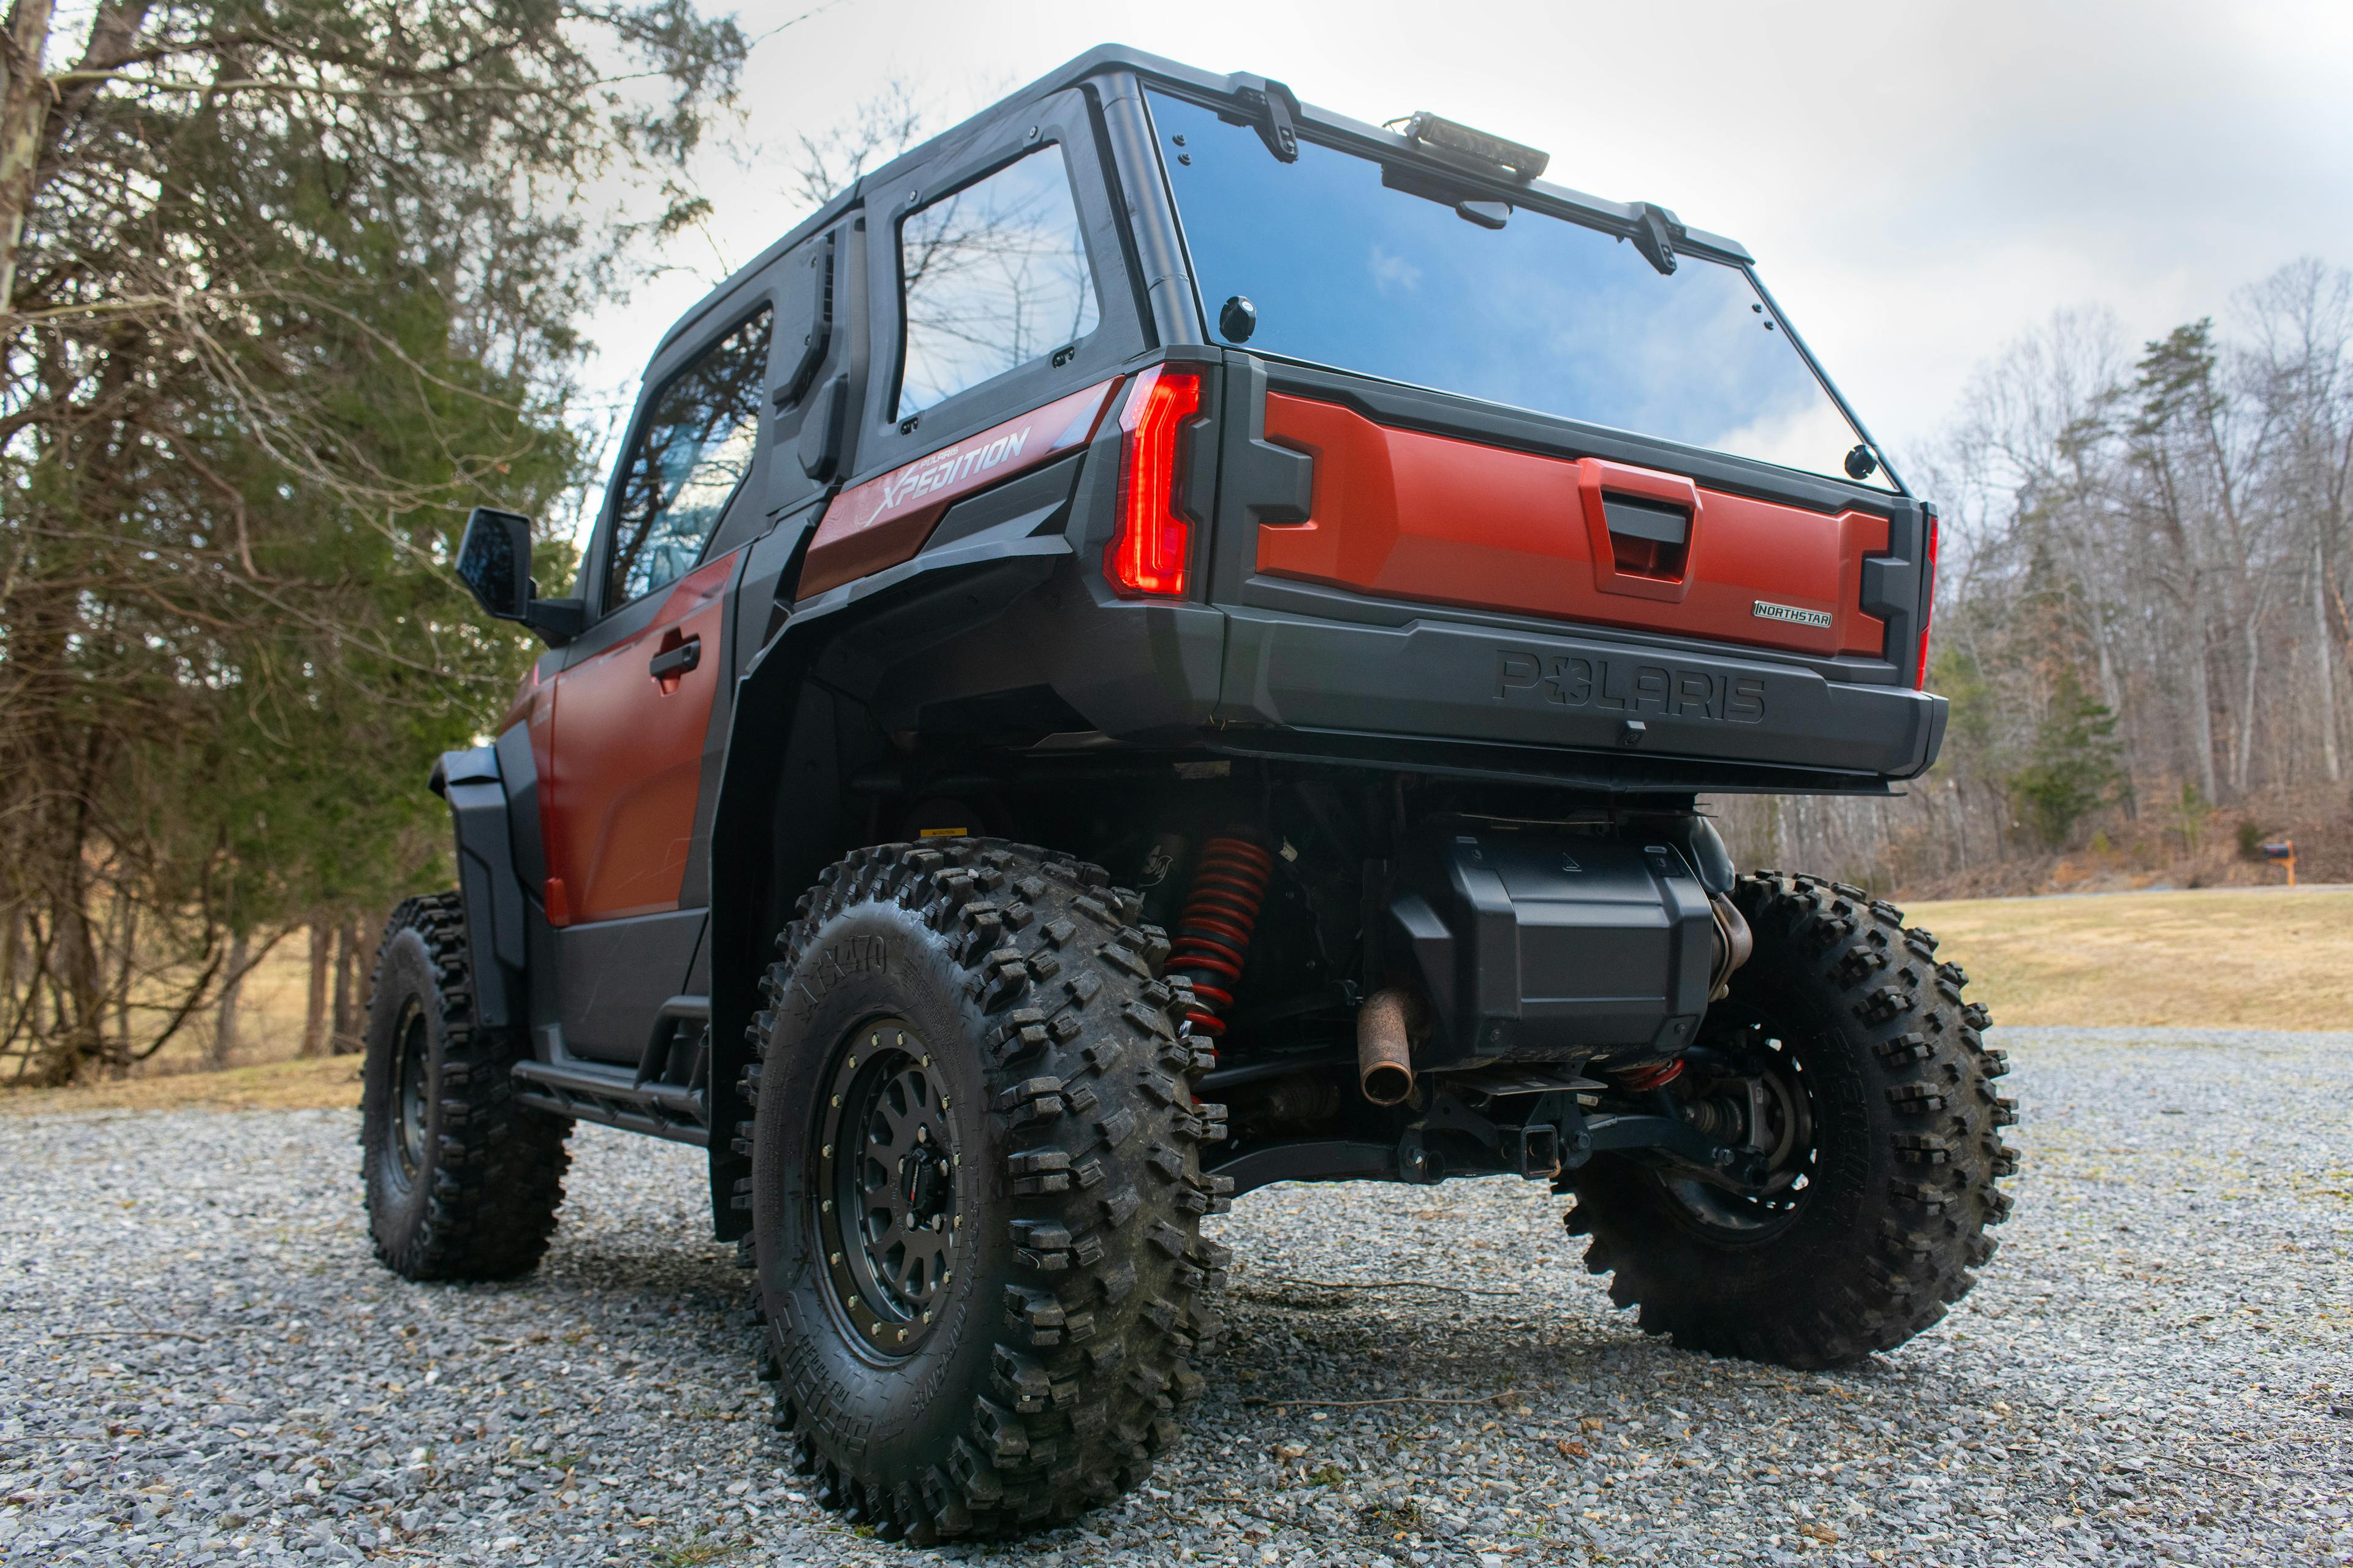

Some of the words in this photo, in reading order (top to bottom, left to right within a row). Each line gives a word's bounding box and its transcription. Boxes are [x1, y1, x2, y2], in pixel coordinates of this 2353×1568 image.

[865, 426, 1032, 527] XPEDITION
[920, 446, 959, 469] POLARIS
[1758, 605, 1829, 624] NORTHSTAR
[1491, 650, 1765, 724] POLARIS
